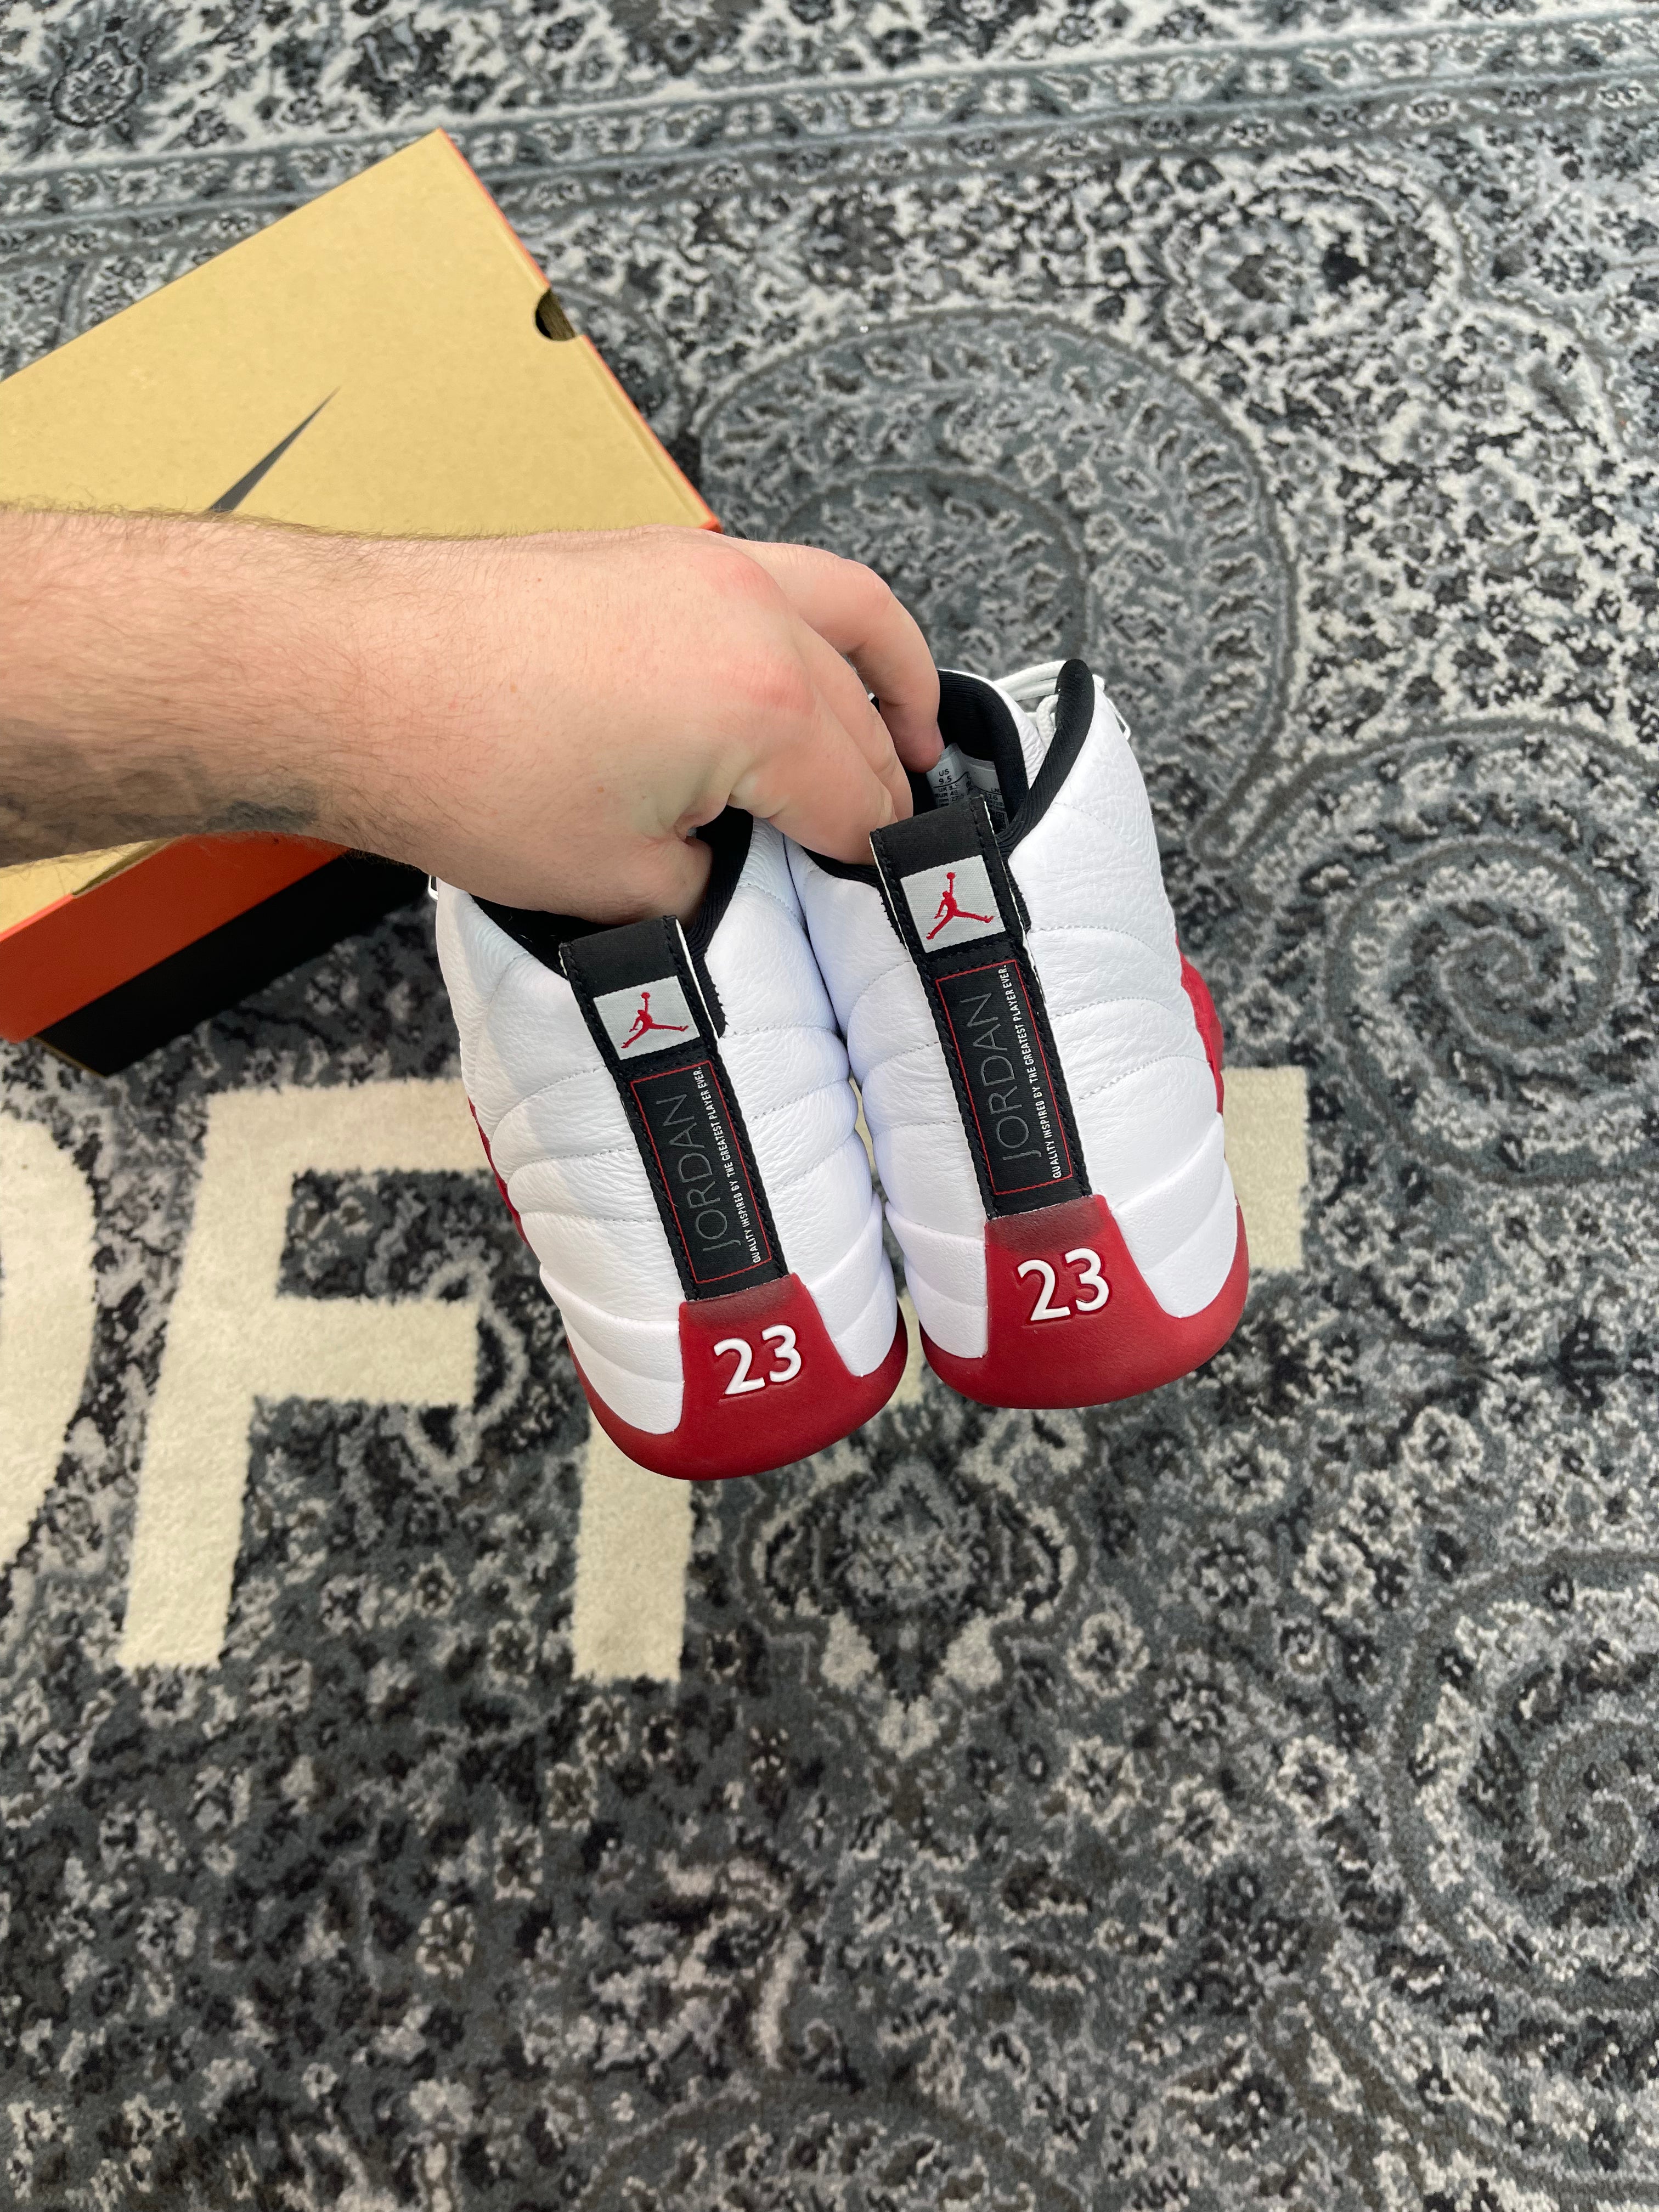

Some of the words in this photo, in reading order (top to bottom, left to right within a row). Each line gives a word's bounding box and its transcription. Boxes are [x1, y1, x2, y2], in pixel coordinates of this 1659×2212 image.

[938, 768, 950, 777] US
[939, 775, 952, 785] 9.5
[998, 964, 1012, 989] EVER.
[1005, 989, 1022, 1022] PLAYER
[1014, 1024, 1035, 1065] GREATEST
[693, 1066, 707, 1089] EVER.
[960, 992, 1042, 1160] JORDAN
[1026, 1066, 1039, 1084] THE
[700, 1090, 718, 1120] PLAYER
[1031, 1086, 1042, 1098] BY
[1035, 1100, 1053, 1138] INSPIRED
[710, 1121, 731, 1161] GREATEST
[655, 1093, 742, 1252] JORDAN
[724, 1161, 735, 1178] THE
[1045, 1141, 1062, 1179] QUALITY
[729, 1180, 740, 1192] BY
[733, 1192, 751, 1228] INSPIRED
[743, 1229, 761, 1263] QUALITY
[1018, 1247, 1110, 1321] 23
[713, 1324, 802, 1395] 23
